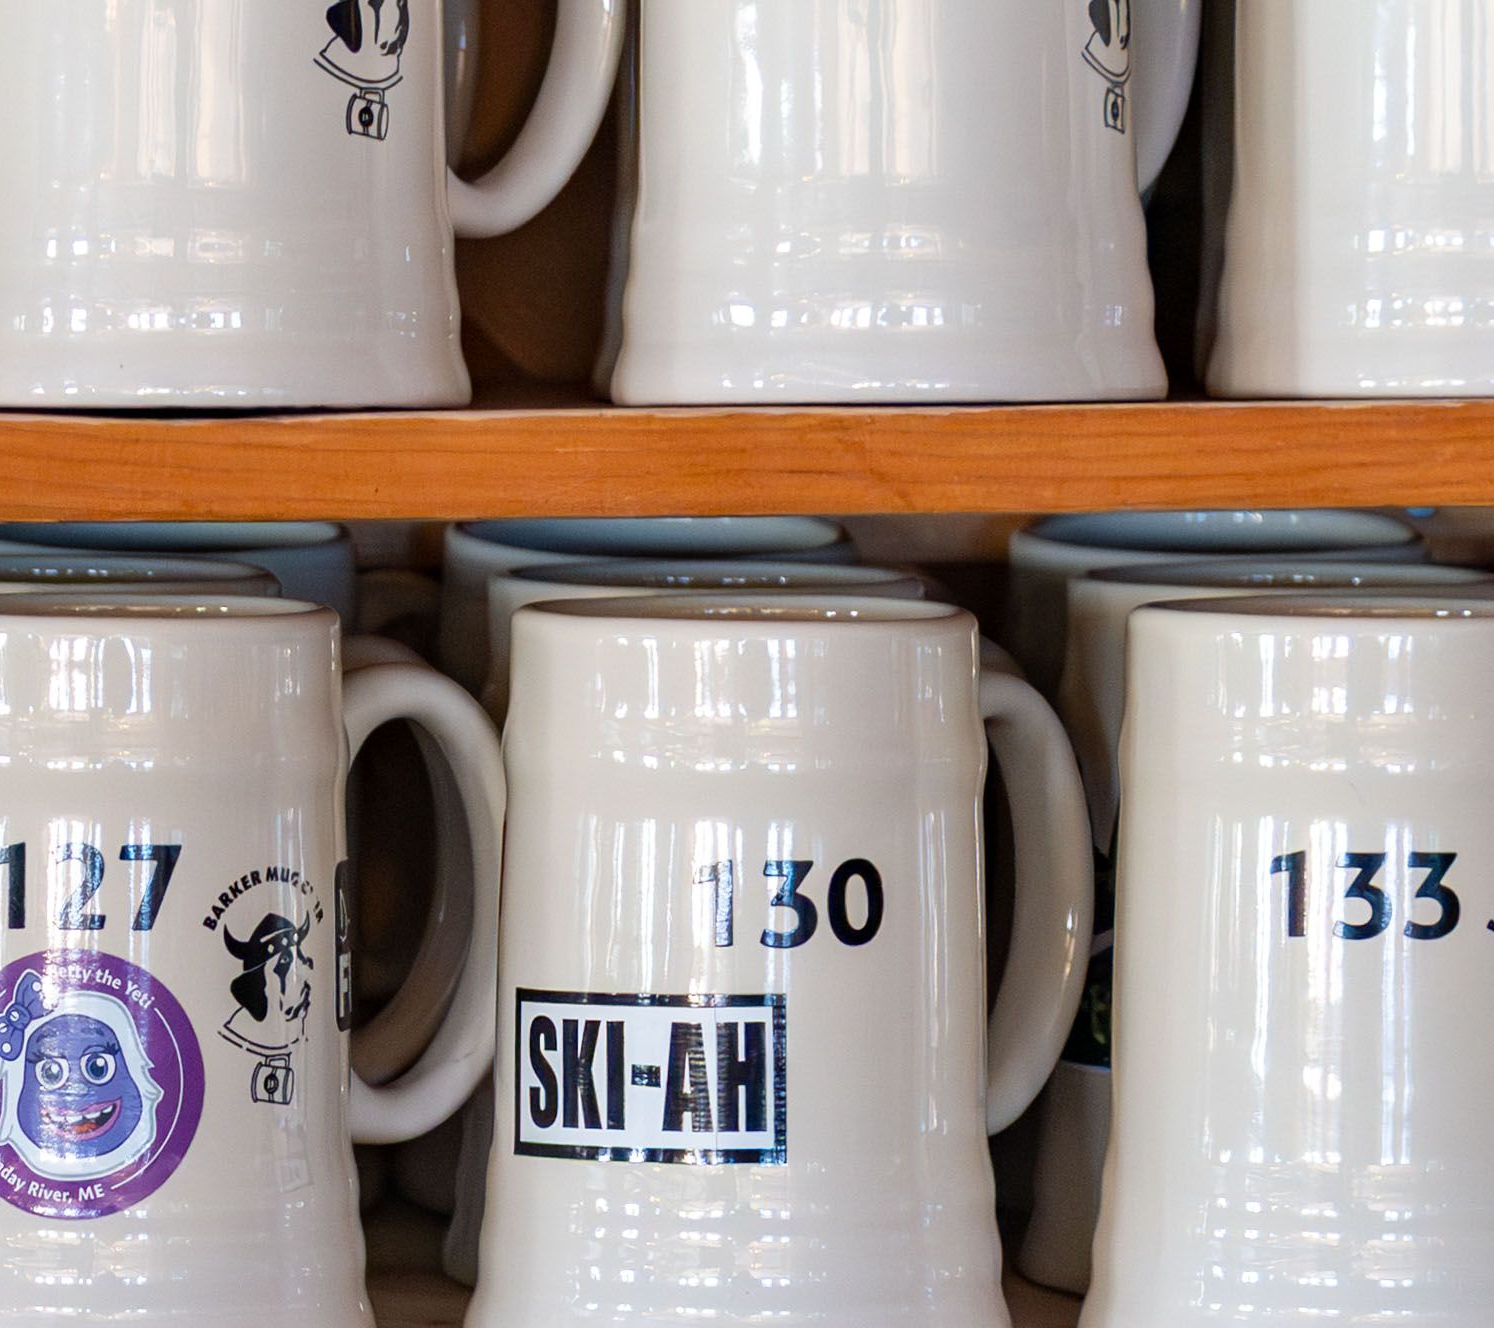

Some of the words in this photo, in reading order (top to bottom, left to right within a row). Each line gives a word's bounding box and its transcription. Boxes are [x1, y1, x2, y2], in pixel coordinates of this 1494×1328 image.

[692, 858, 885, 948] 130
[1270, 850, 1461, 942] 133
[95, 966, 122, 991] the
[126, 979, 156, 1010] Yeti
[527, 1015, 767, 1133] SKI-AH
[27, 1180, 70, 1205] River,
[77, 1183, 105, 1202] ME
